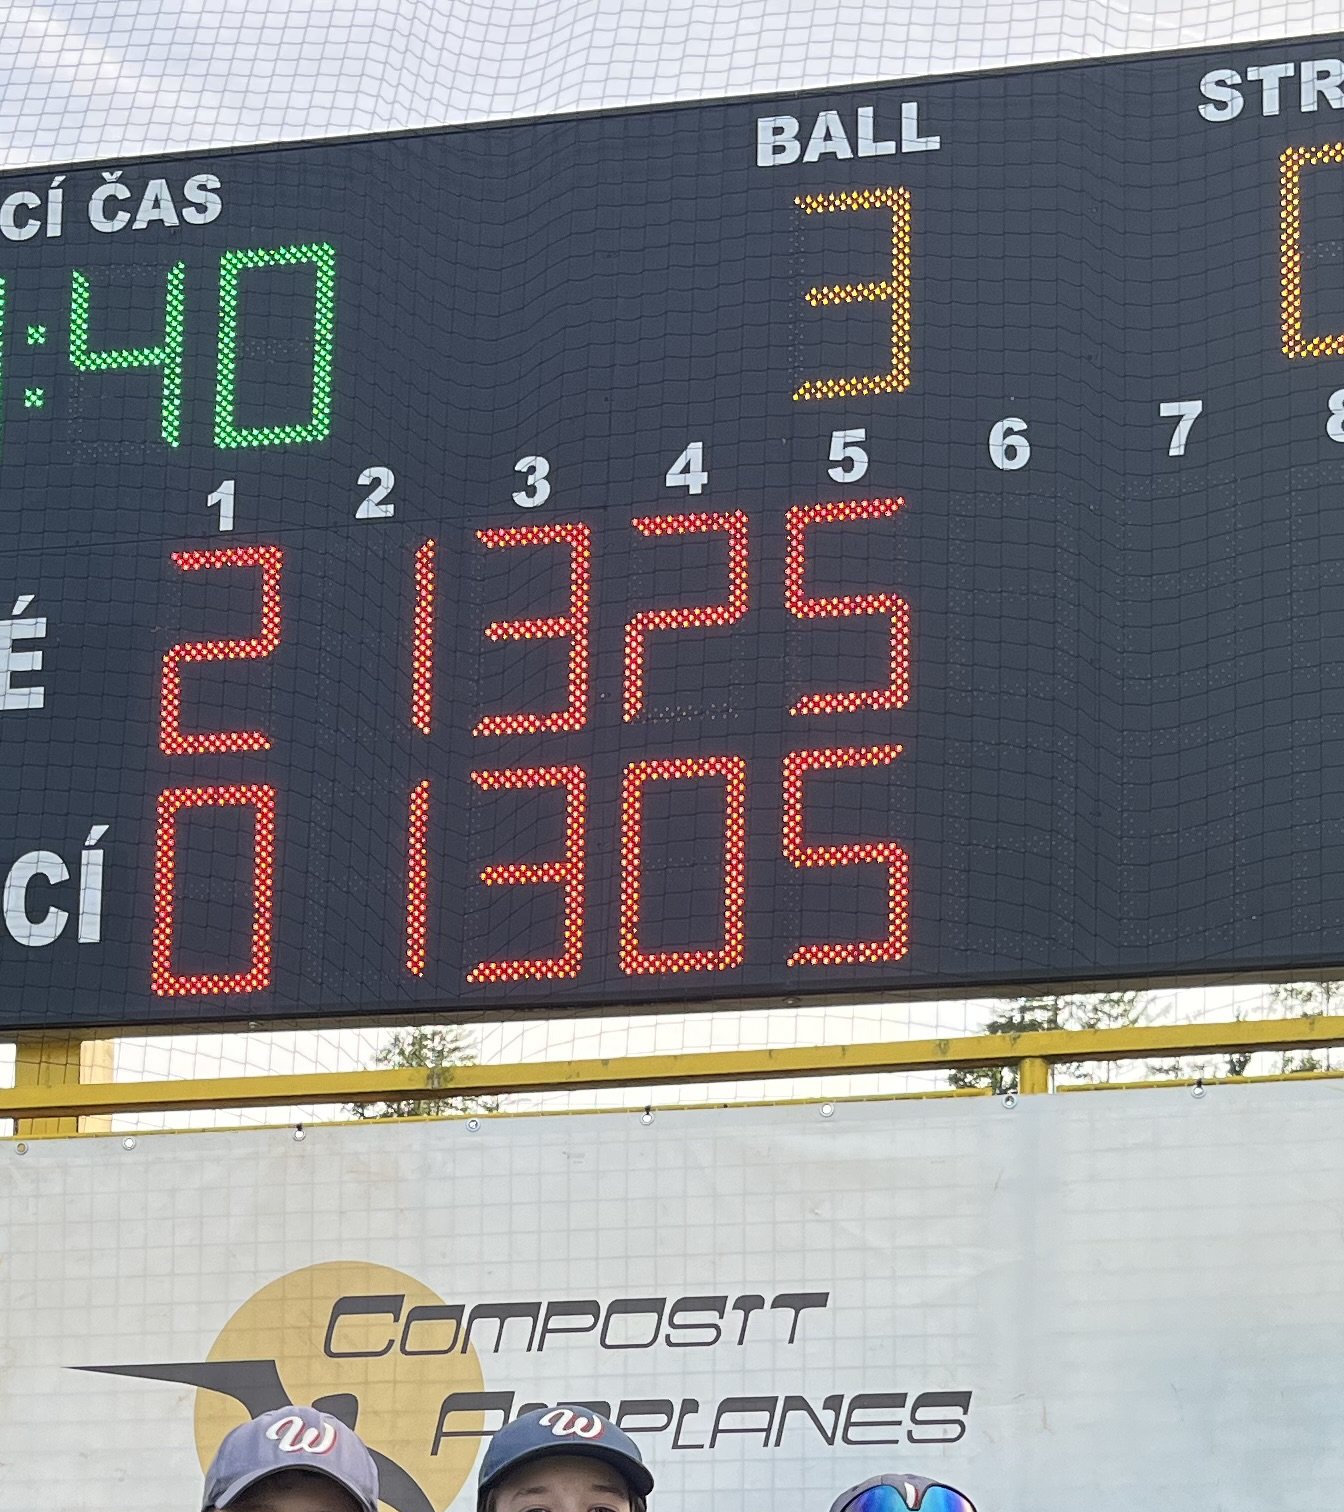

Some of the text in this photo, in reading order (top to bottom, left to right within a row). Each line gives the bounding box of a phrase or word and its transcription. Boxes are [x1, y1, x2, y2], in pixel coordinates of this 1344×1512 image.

[757, 101, 941, 167] BALL
[88, 171, 222, 233] ČAS
[792, 186, 911, 401] 3
[207, 480, 236, 532] 1
[354, 466, 396, 519] 2
[511, 455, 552, 508] 3
[665, 441, 709, 495] 4
[827, 428, 869, 483] 5
[988, 417, 1031, 471] 6
[1159, 399, 1203, 457] 7
